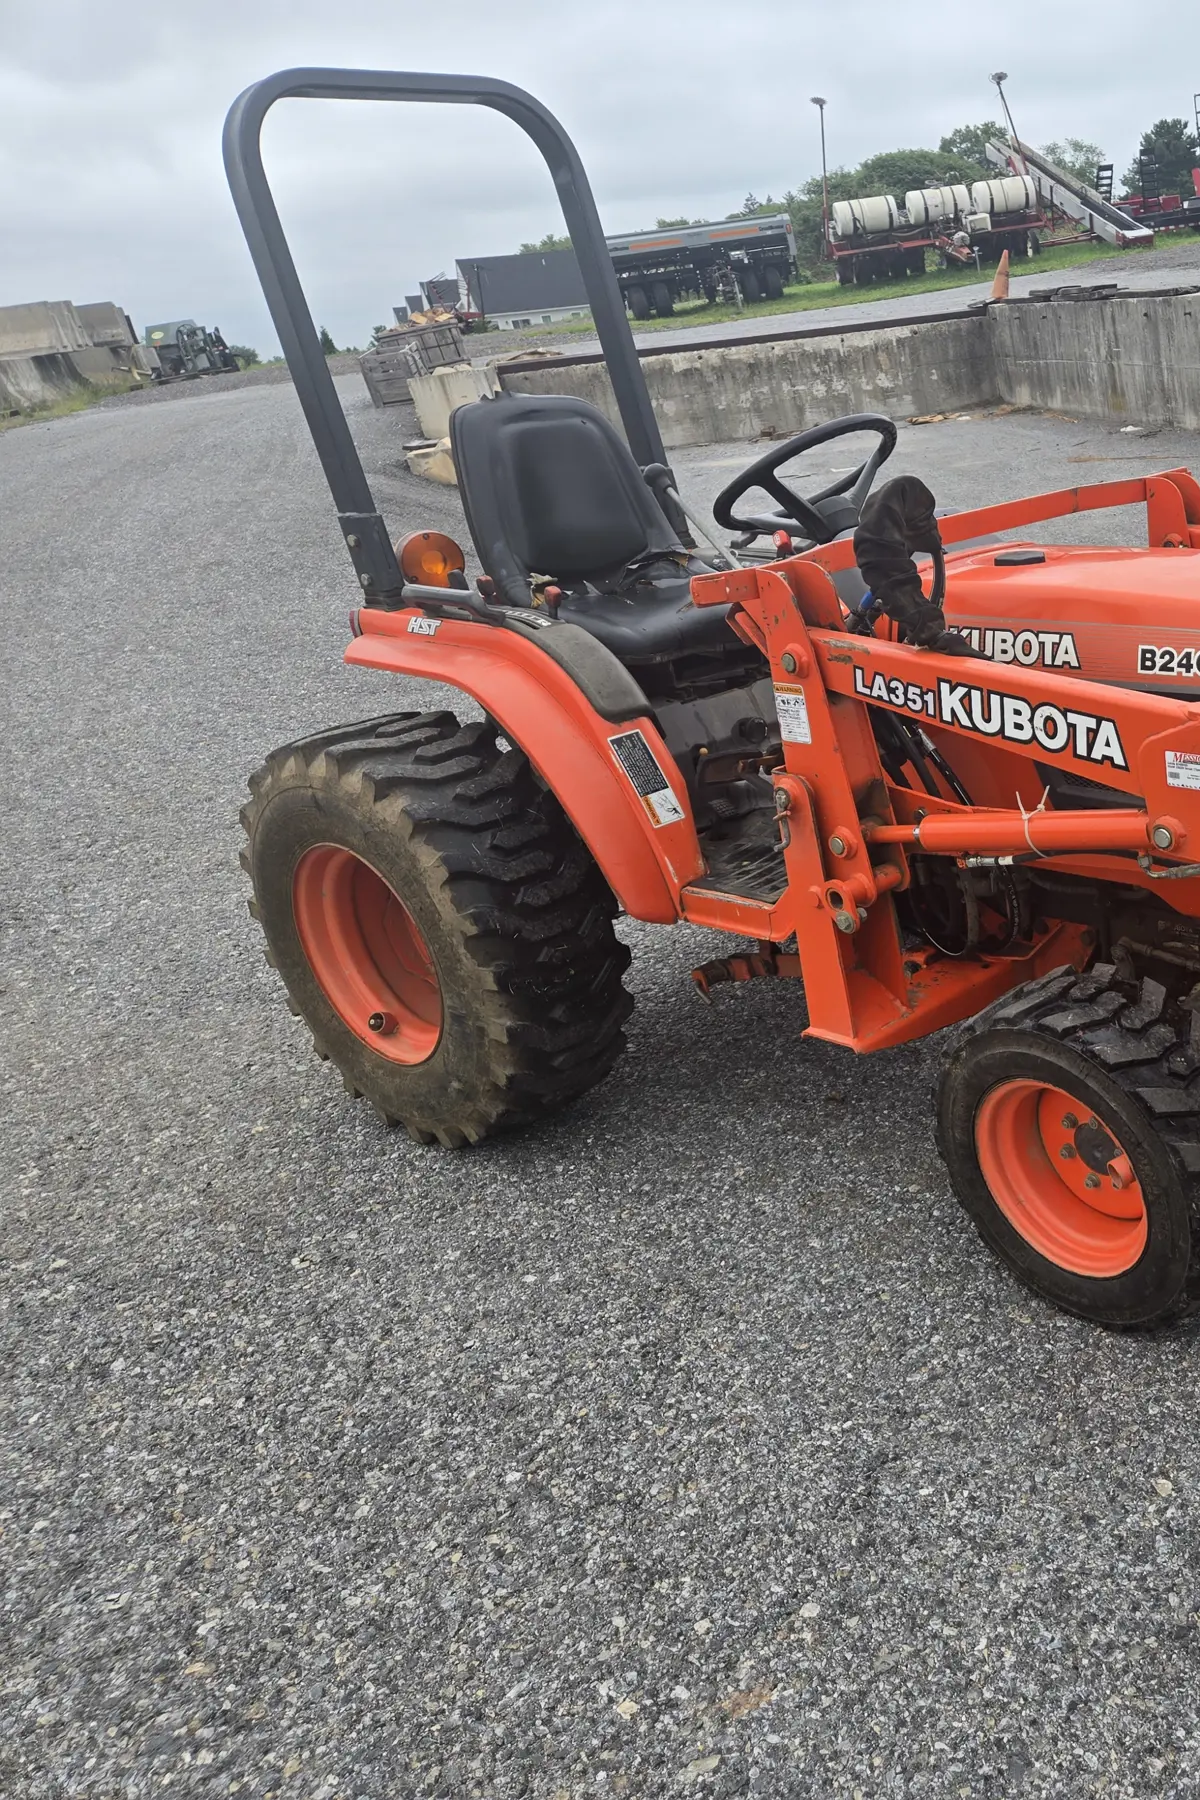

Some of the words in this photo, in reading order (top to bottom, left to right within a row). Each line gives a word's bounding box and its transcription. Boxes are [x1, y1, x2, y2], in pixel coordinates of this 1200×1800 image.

[407, 616, 442, 636] HST
[853, 665, 937, 718] LA351
[936, 677, 1130, 770] KUBOTA
